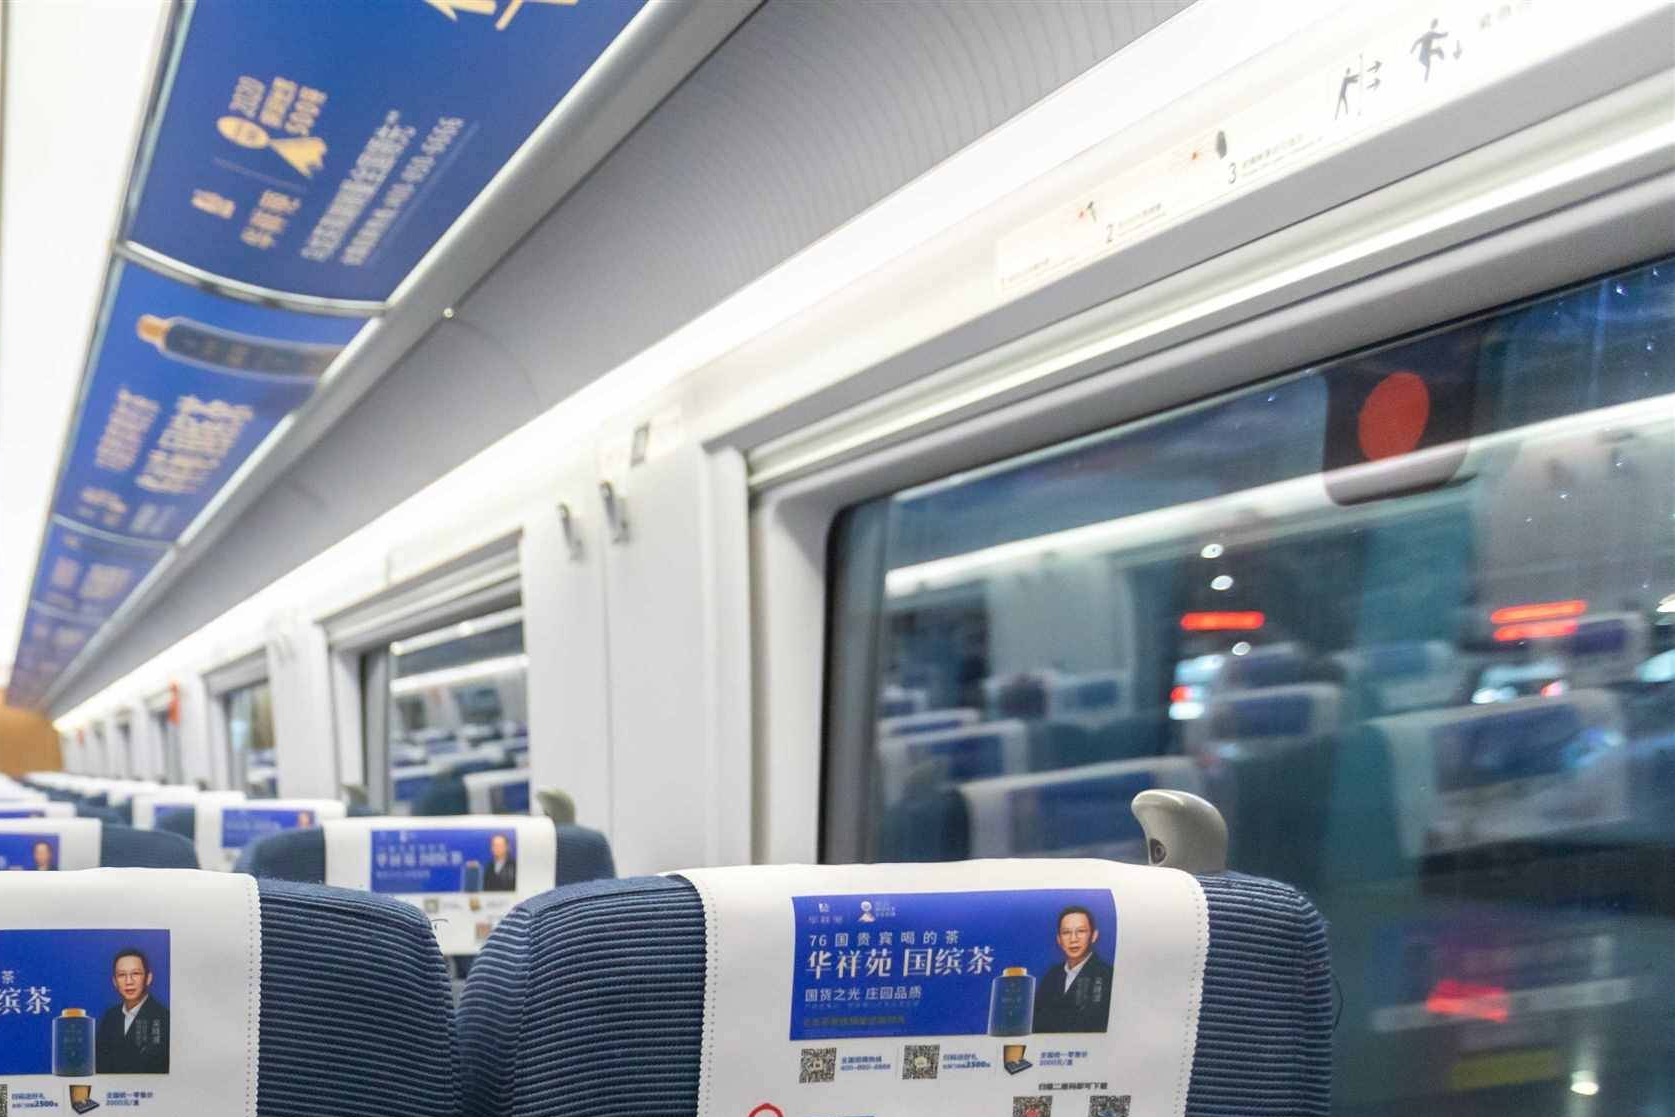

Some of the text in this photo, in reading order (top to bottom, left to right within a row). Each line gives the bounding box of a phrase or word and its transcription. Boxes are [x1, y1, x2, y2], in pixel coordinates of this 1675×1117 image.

[805, 946, 995, 980] 华祥苑 国缤茶
